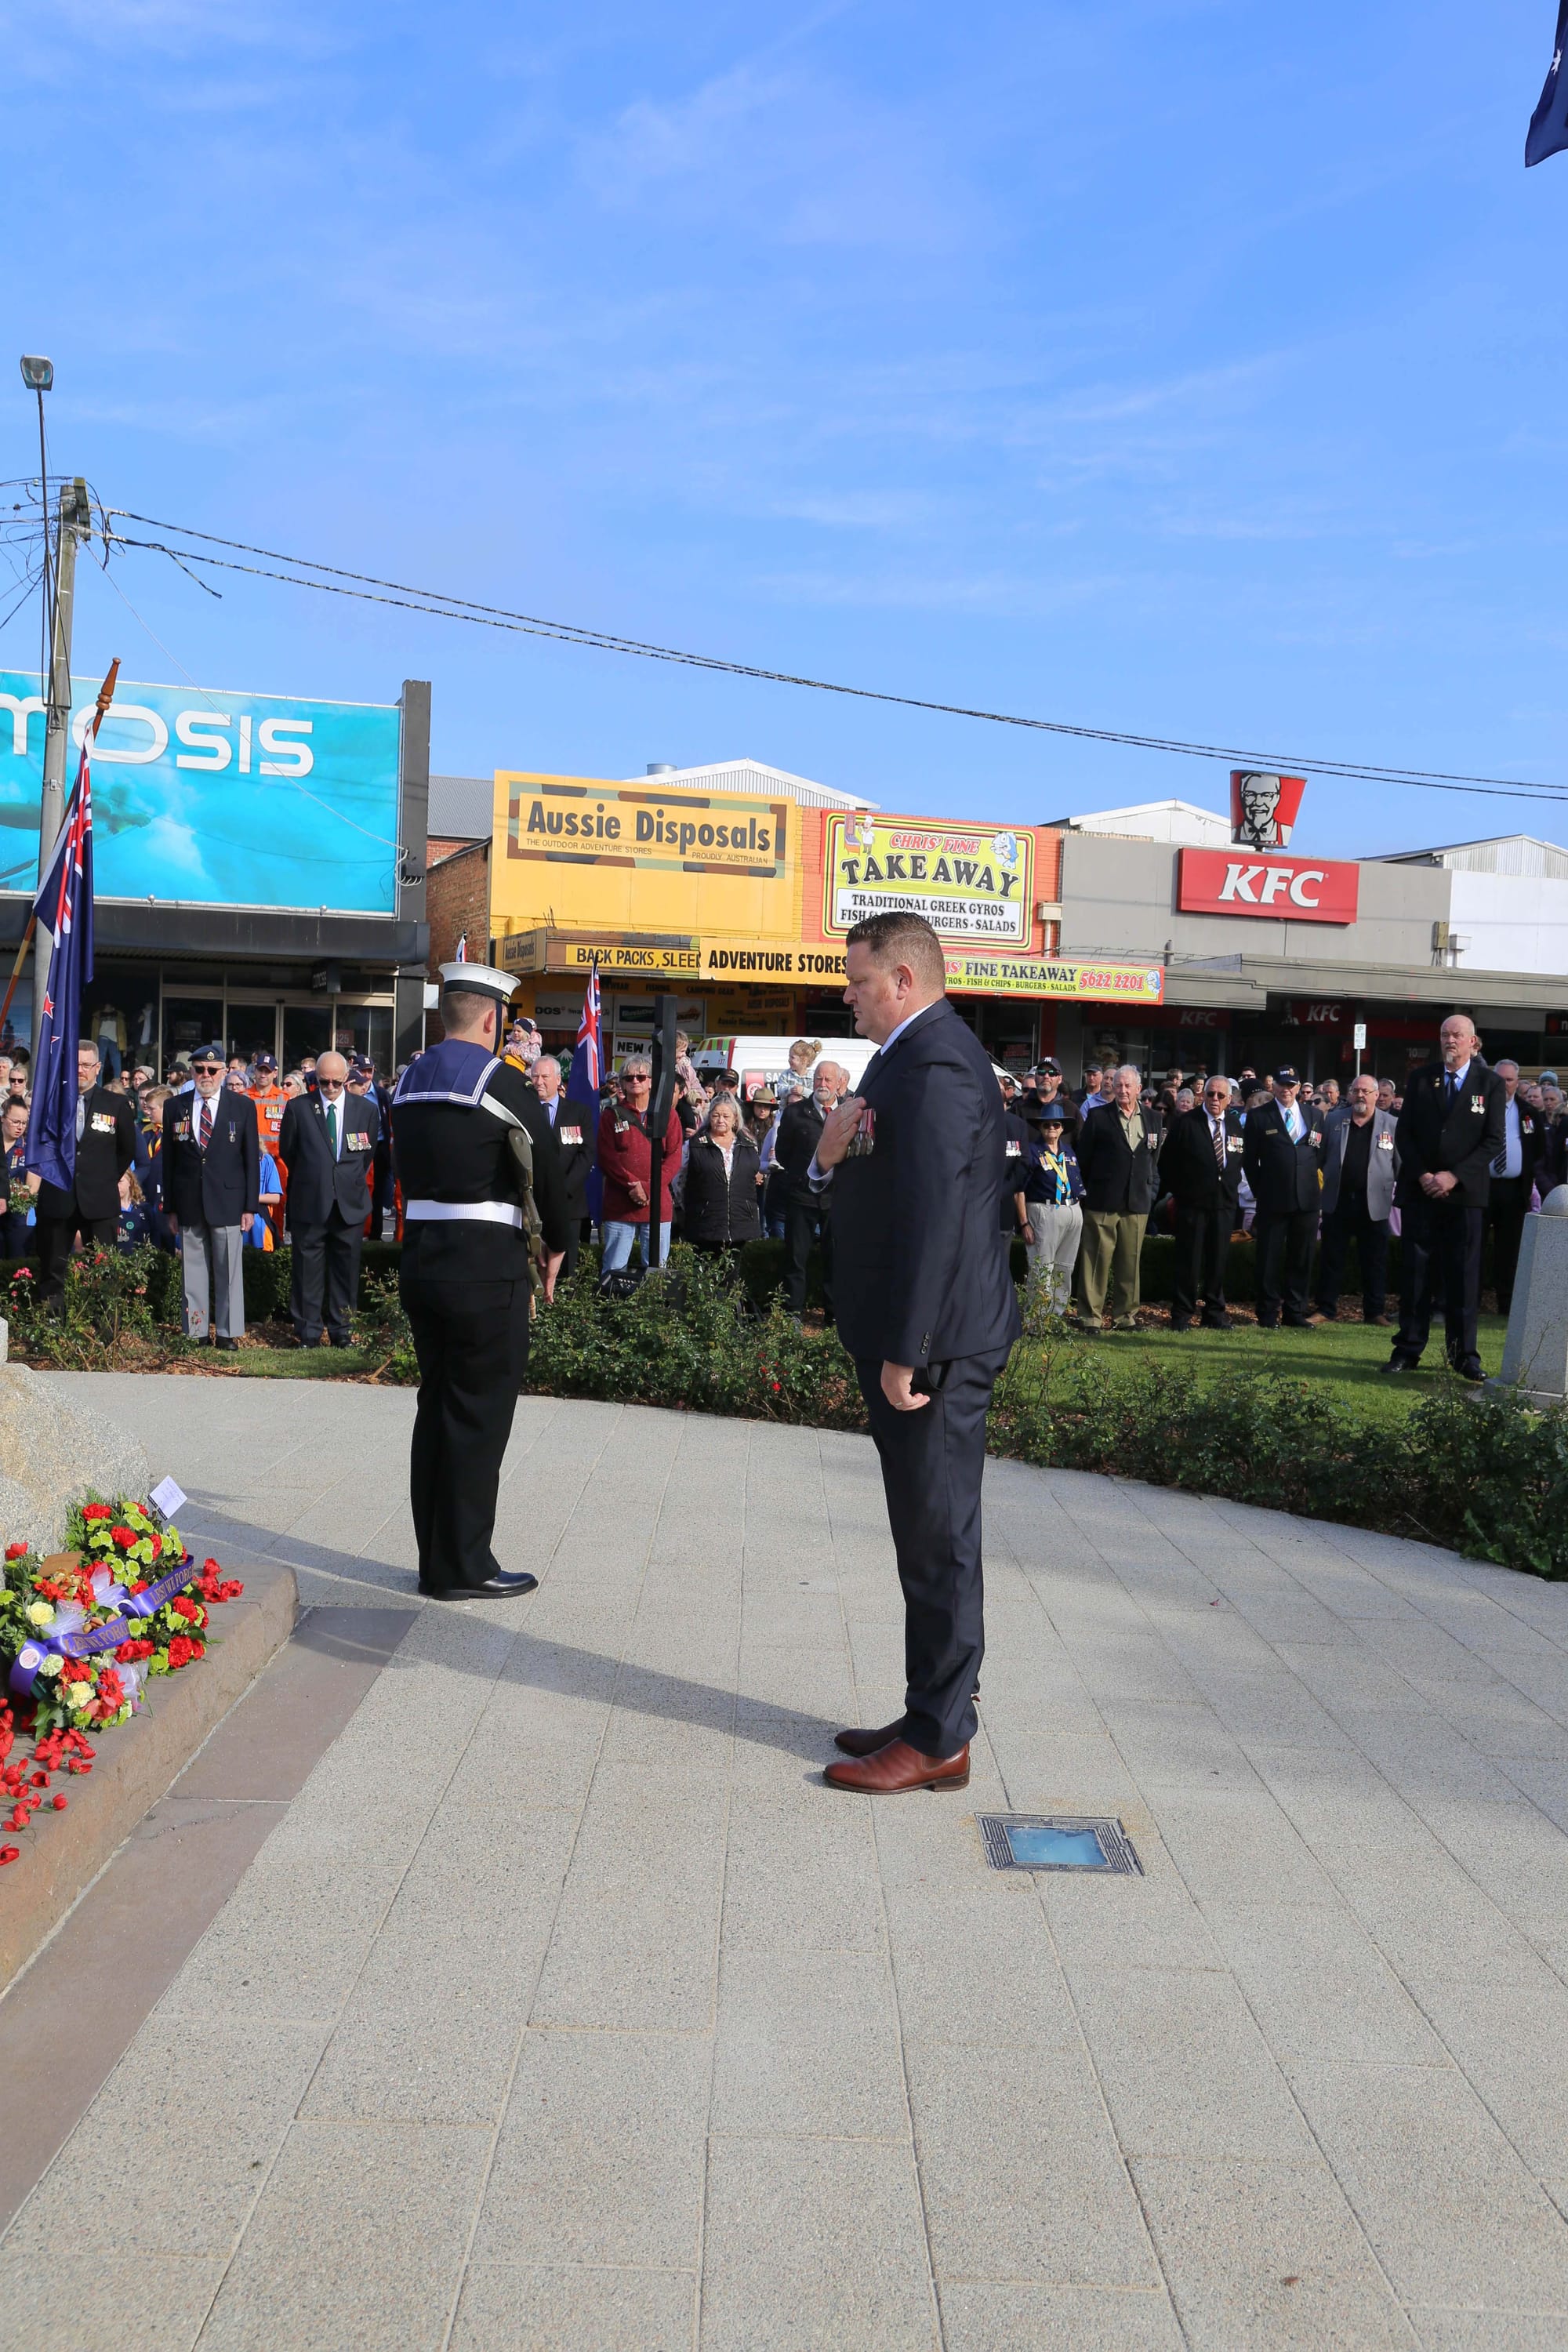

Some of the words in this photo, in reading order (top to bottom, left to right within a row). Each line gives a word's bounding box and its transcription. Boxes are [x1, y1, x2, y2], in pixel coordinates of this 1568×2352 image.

[527, 800, 621, 840] Aussie
[636, 808, 771, 855] Disposals
[543, 840, 579, 849] OUTDOOR
[580, 843, 622, 853] ADVENTURE
[891, 833, 941, 851] CHRIS'
[942, 837, 980, 855] FINE
[691, 851, 722, 861] PROUDLY
[727, 854, 768, 865] AUSTRALIAN
[1218, 863, 1325, 908] KFC
[852, 894, 928, 911] TRADITIONAL
[930, 902, 967, 913] GREEK
[970, 904, 1004, 916] GYROS
[840, 909, 866, 921] FISH
[975, 920, 1016, 932] SALADS
[576, 947, 612, 964] BACK
[708, 949, 793, 972] ADVENTURE
[797, 953, 848, 974] STORES
[965, 961, 998, 977] FINE
[1001, 964, 1077, 982] TAKEAWAY
[1079, 969, 1112, 989] 5622
[1114, 973, 1145, 991] 2201
[967, 978, 982, 986] FISH
[991, 979, 1011, 988] CHIPS
[1015, 981, 1047, 990] BURGERS
[1051, 982, 1076, 993] SALADS
[1179, 1011, 1218, 1026] KFC
[1307, 1004, 1341, 1022] KFC
[617, 1040, 644, 1054] NEW
